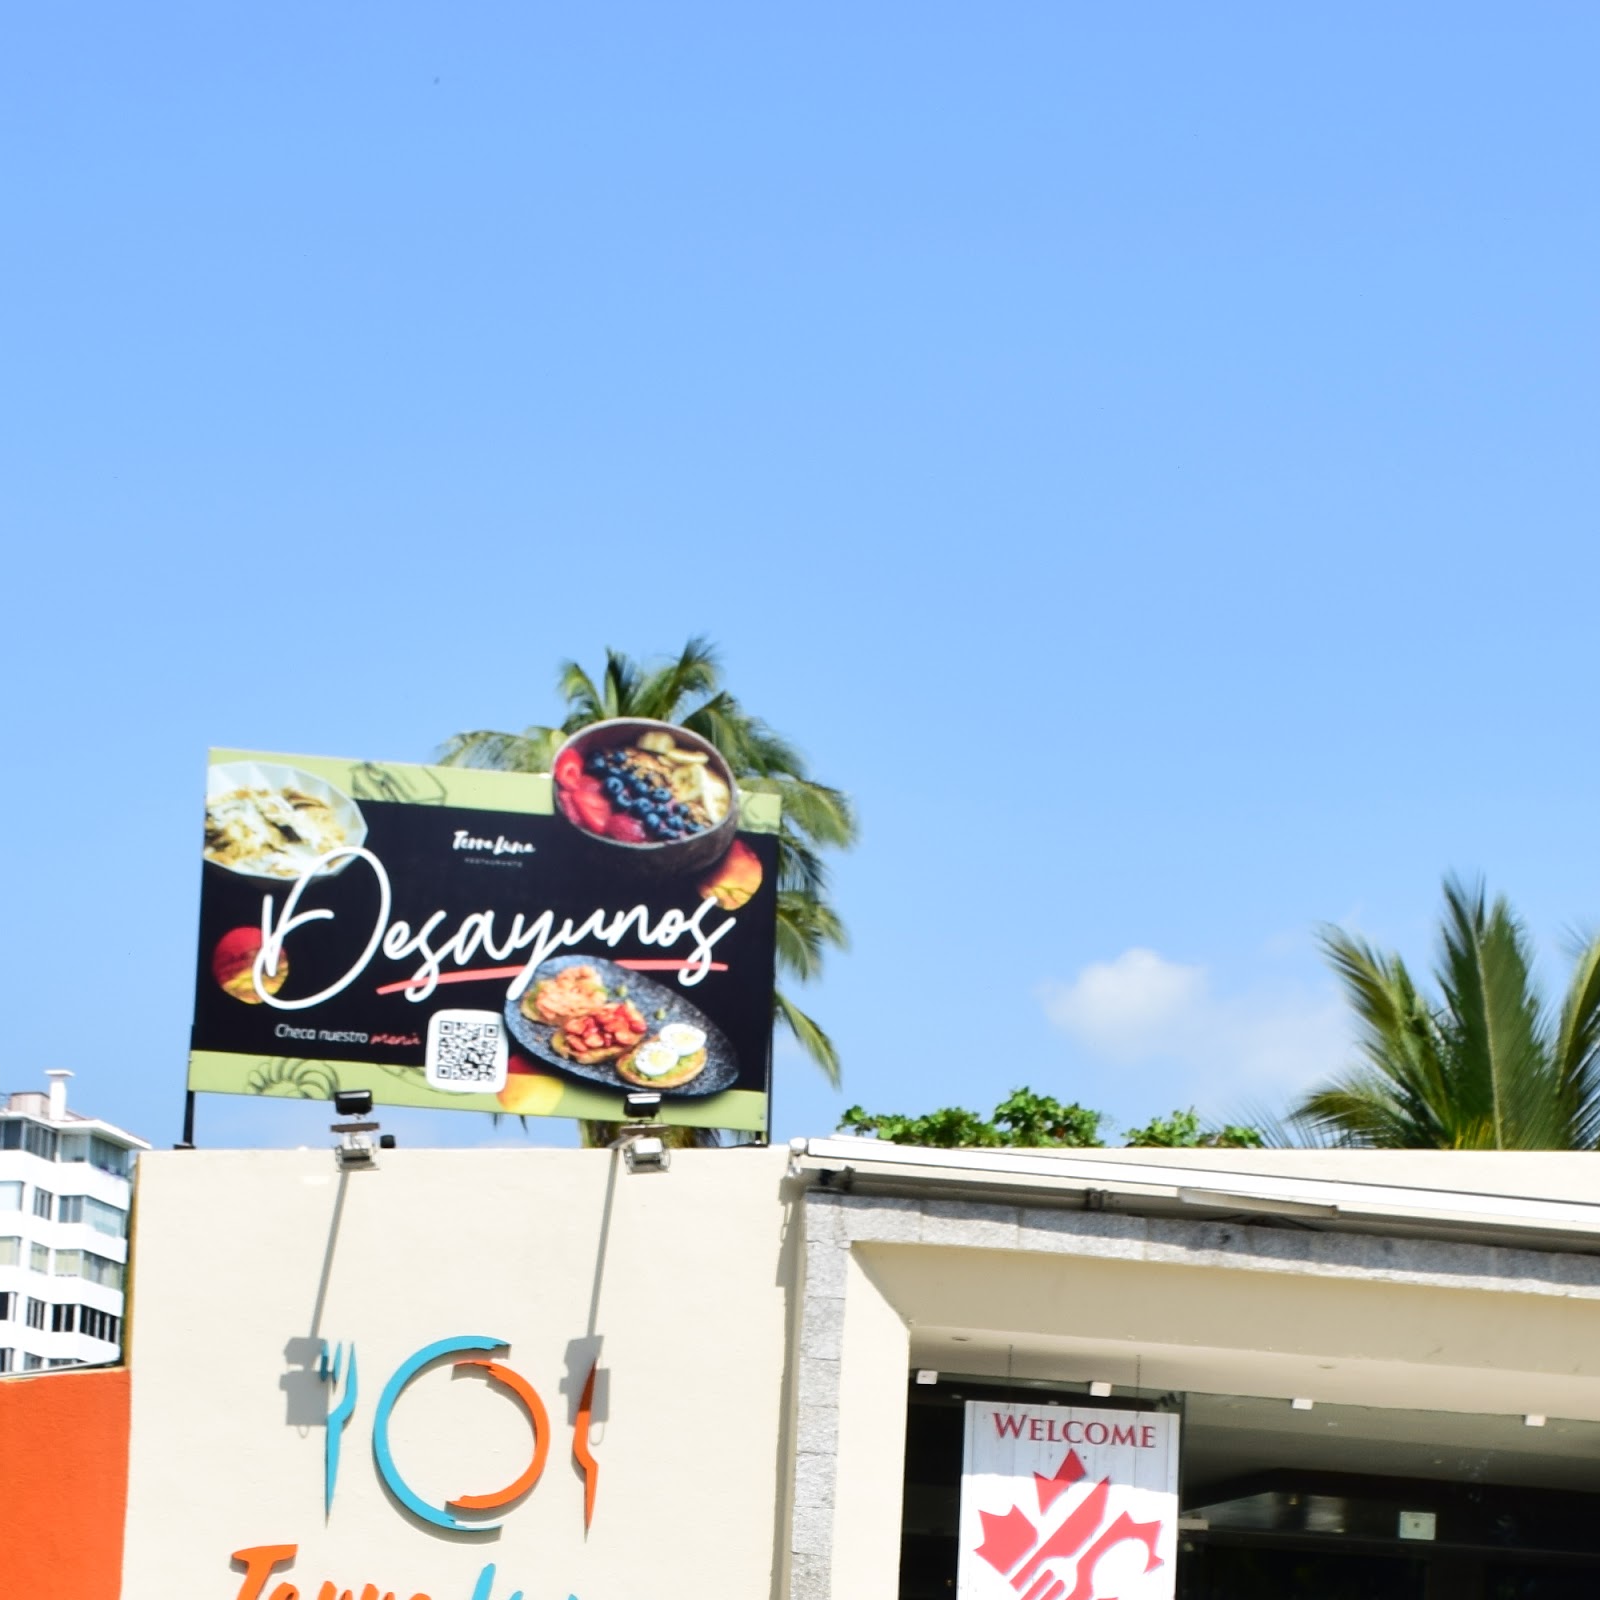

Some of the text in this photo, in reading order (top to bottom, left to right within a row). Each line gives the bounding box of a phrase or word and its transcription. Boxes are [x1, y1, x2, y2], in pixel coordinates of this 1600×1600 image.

[452, 830, 536, 855] Terra Luna
[252, 846, 737, 1010] Desayunos
[274, 1023, 316, 1039] Checa
[318, 1029, 369, 1043] nuestro
[992, 1412, 1157, 1448] WELCOME
